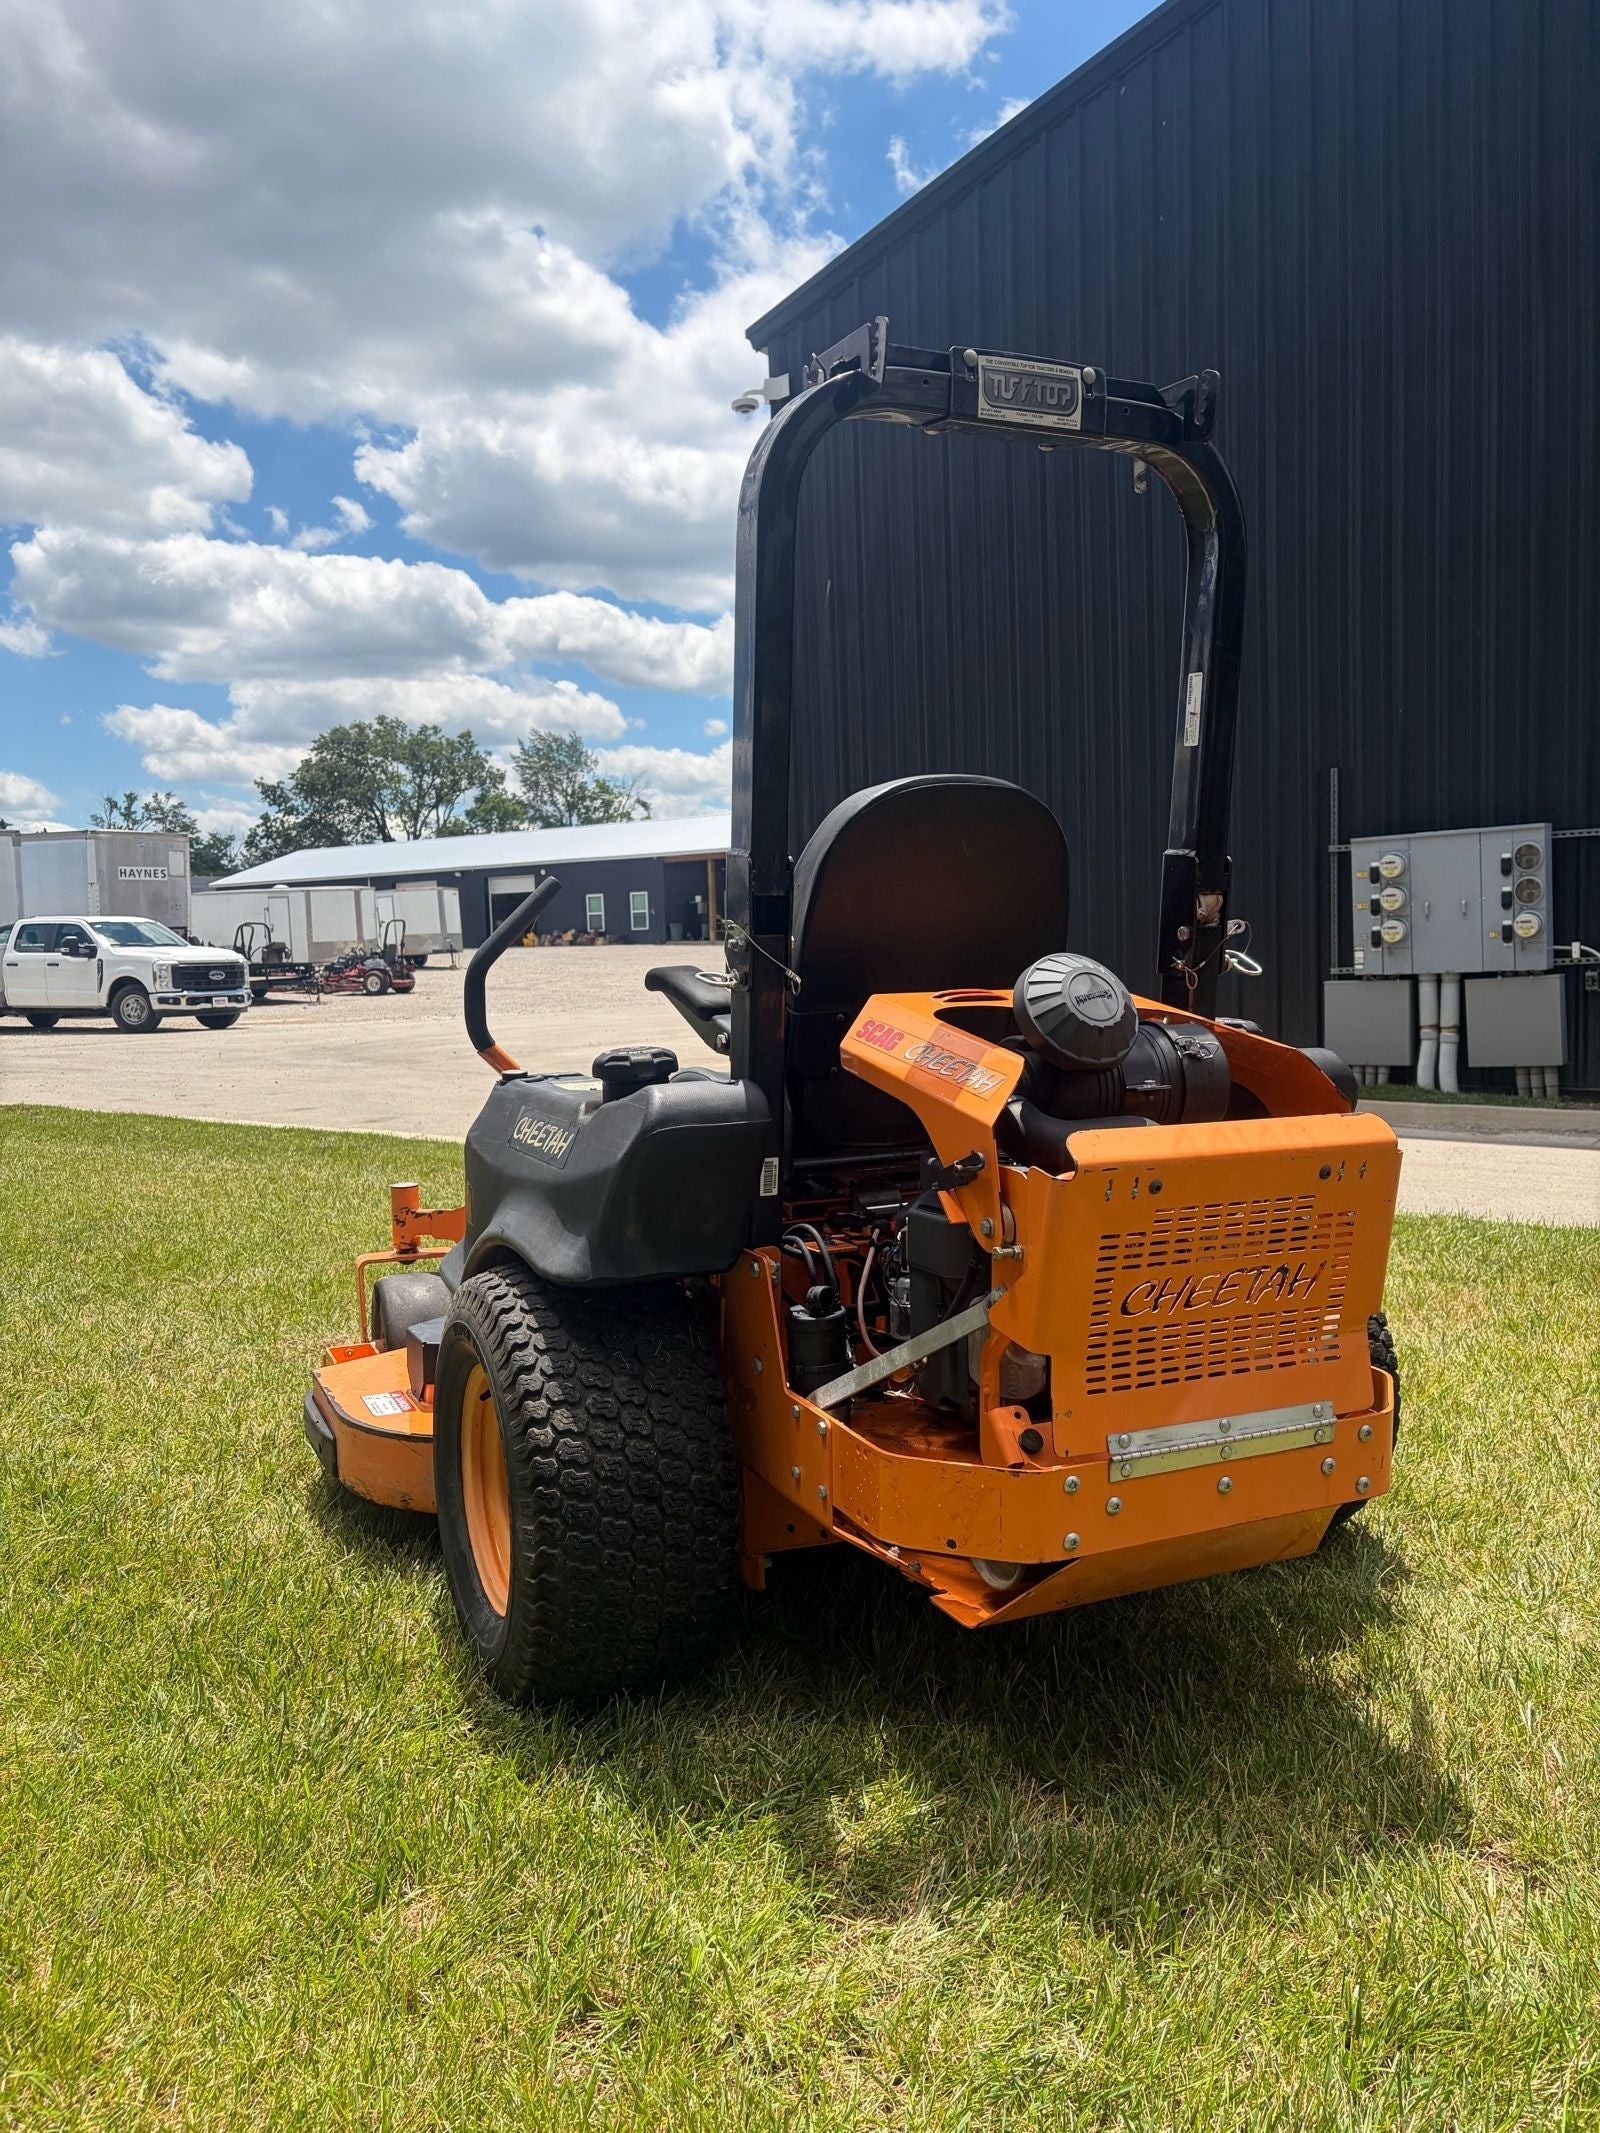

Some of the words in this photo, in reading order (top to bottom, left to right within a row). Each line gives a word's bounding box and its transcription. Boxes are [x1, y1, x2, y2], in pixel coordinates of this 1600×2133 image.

[994, 359, 1019, 368] CONVERTIBLE
[1036, 364, 1055, 373] TRACTORS
[119, 868, 167, 879] HAYNES
[856, 1019, 905, 1052] SCAG
[904, 1042, 1005, 1094] CHEETAH
[513, 1116, 575, 1159] CHEETAH
[1120, 1260, 1328, 1318] CHEETAH
